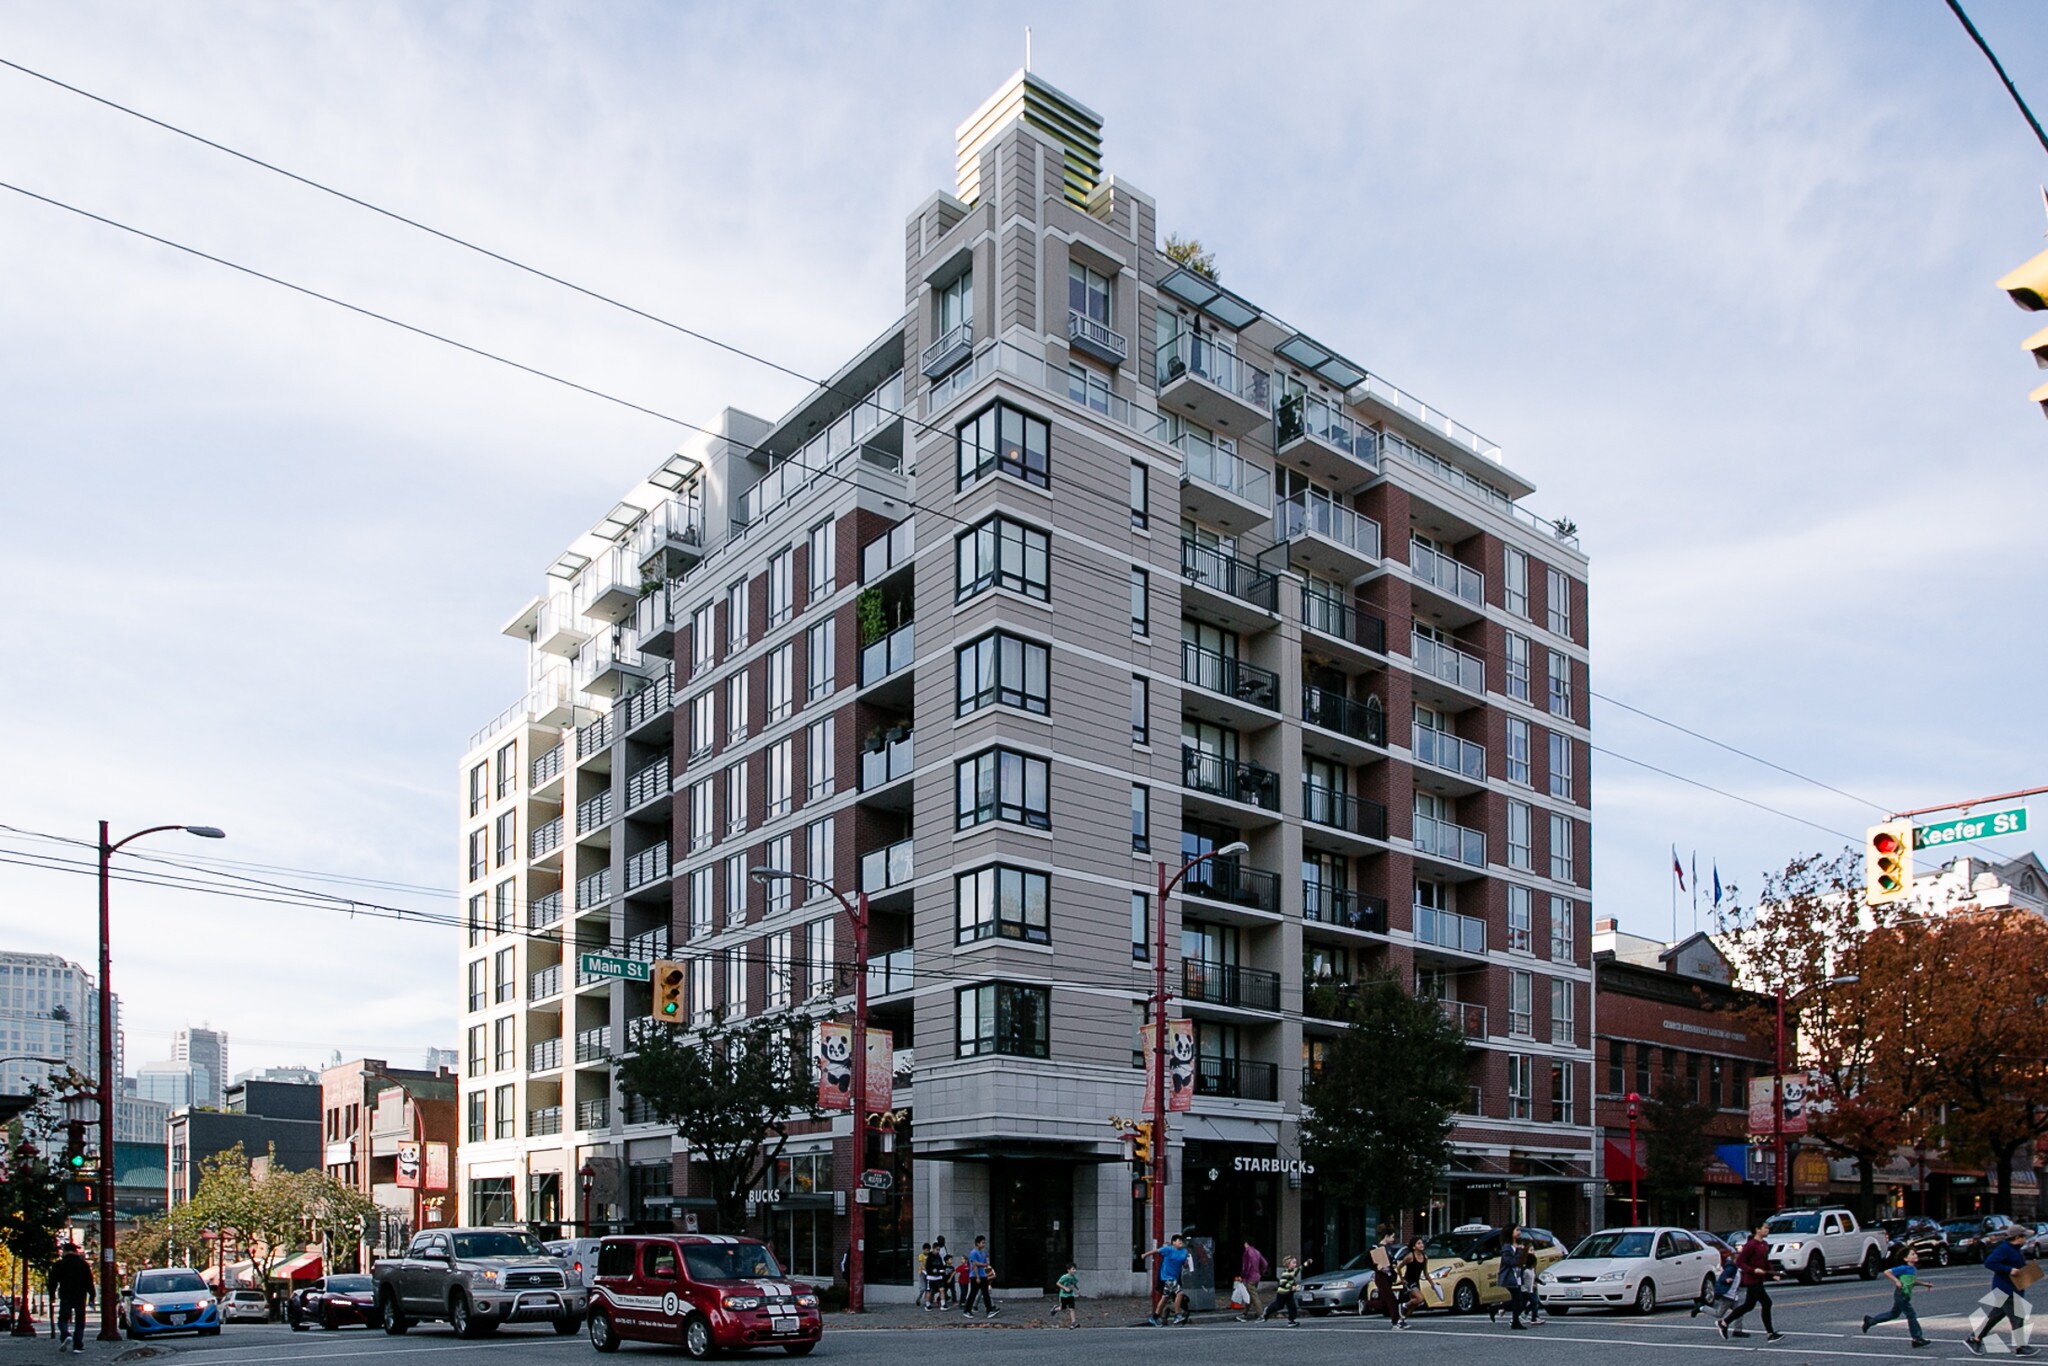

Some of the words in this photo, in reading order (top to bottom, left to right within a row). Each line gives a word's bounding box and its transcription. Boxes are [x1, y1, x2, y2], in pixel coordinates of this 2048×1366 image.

[1914, 821, 1985, 846] Keefer
[1993, 813, 2019, 833] St
[589, 957, 622, 974] Main
[627, 962, 642, 977] St
[1234, 1157, 1315, 1174] STARBUCKS
[667, 1296, 675, 1312] 8
